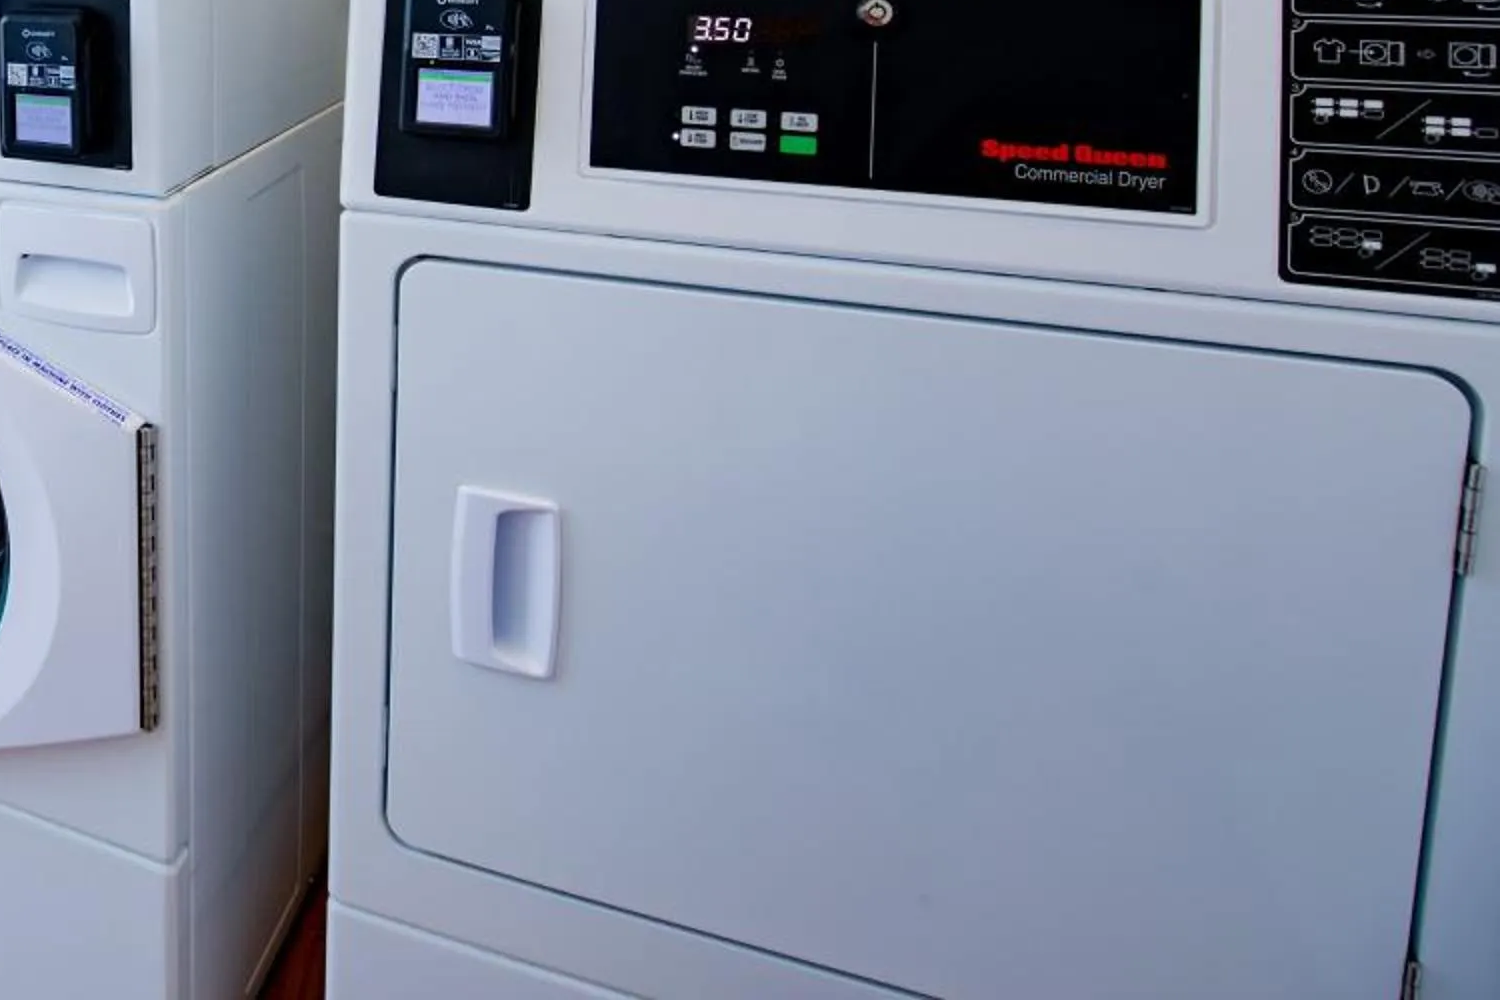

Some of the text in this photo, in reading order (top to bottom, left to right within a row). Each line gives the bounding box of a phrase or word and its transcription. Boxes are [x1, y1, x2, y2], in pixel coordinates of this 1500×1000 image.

[694, 16, 752, 42] 3.50
[980, 138, 1167, 169] Speed Queen
[1014, 163, 1167, 192] Commercial Dryer
